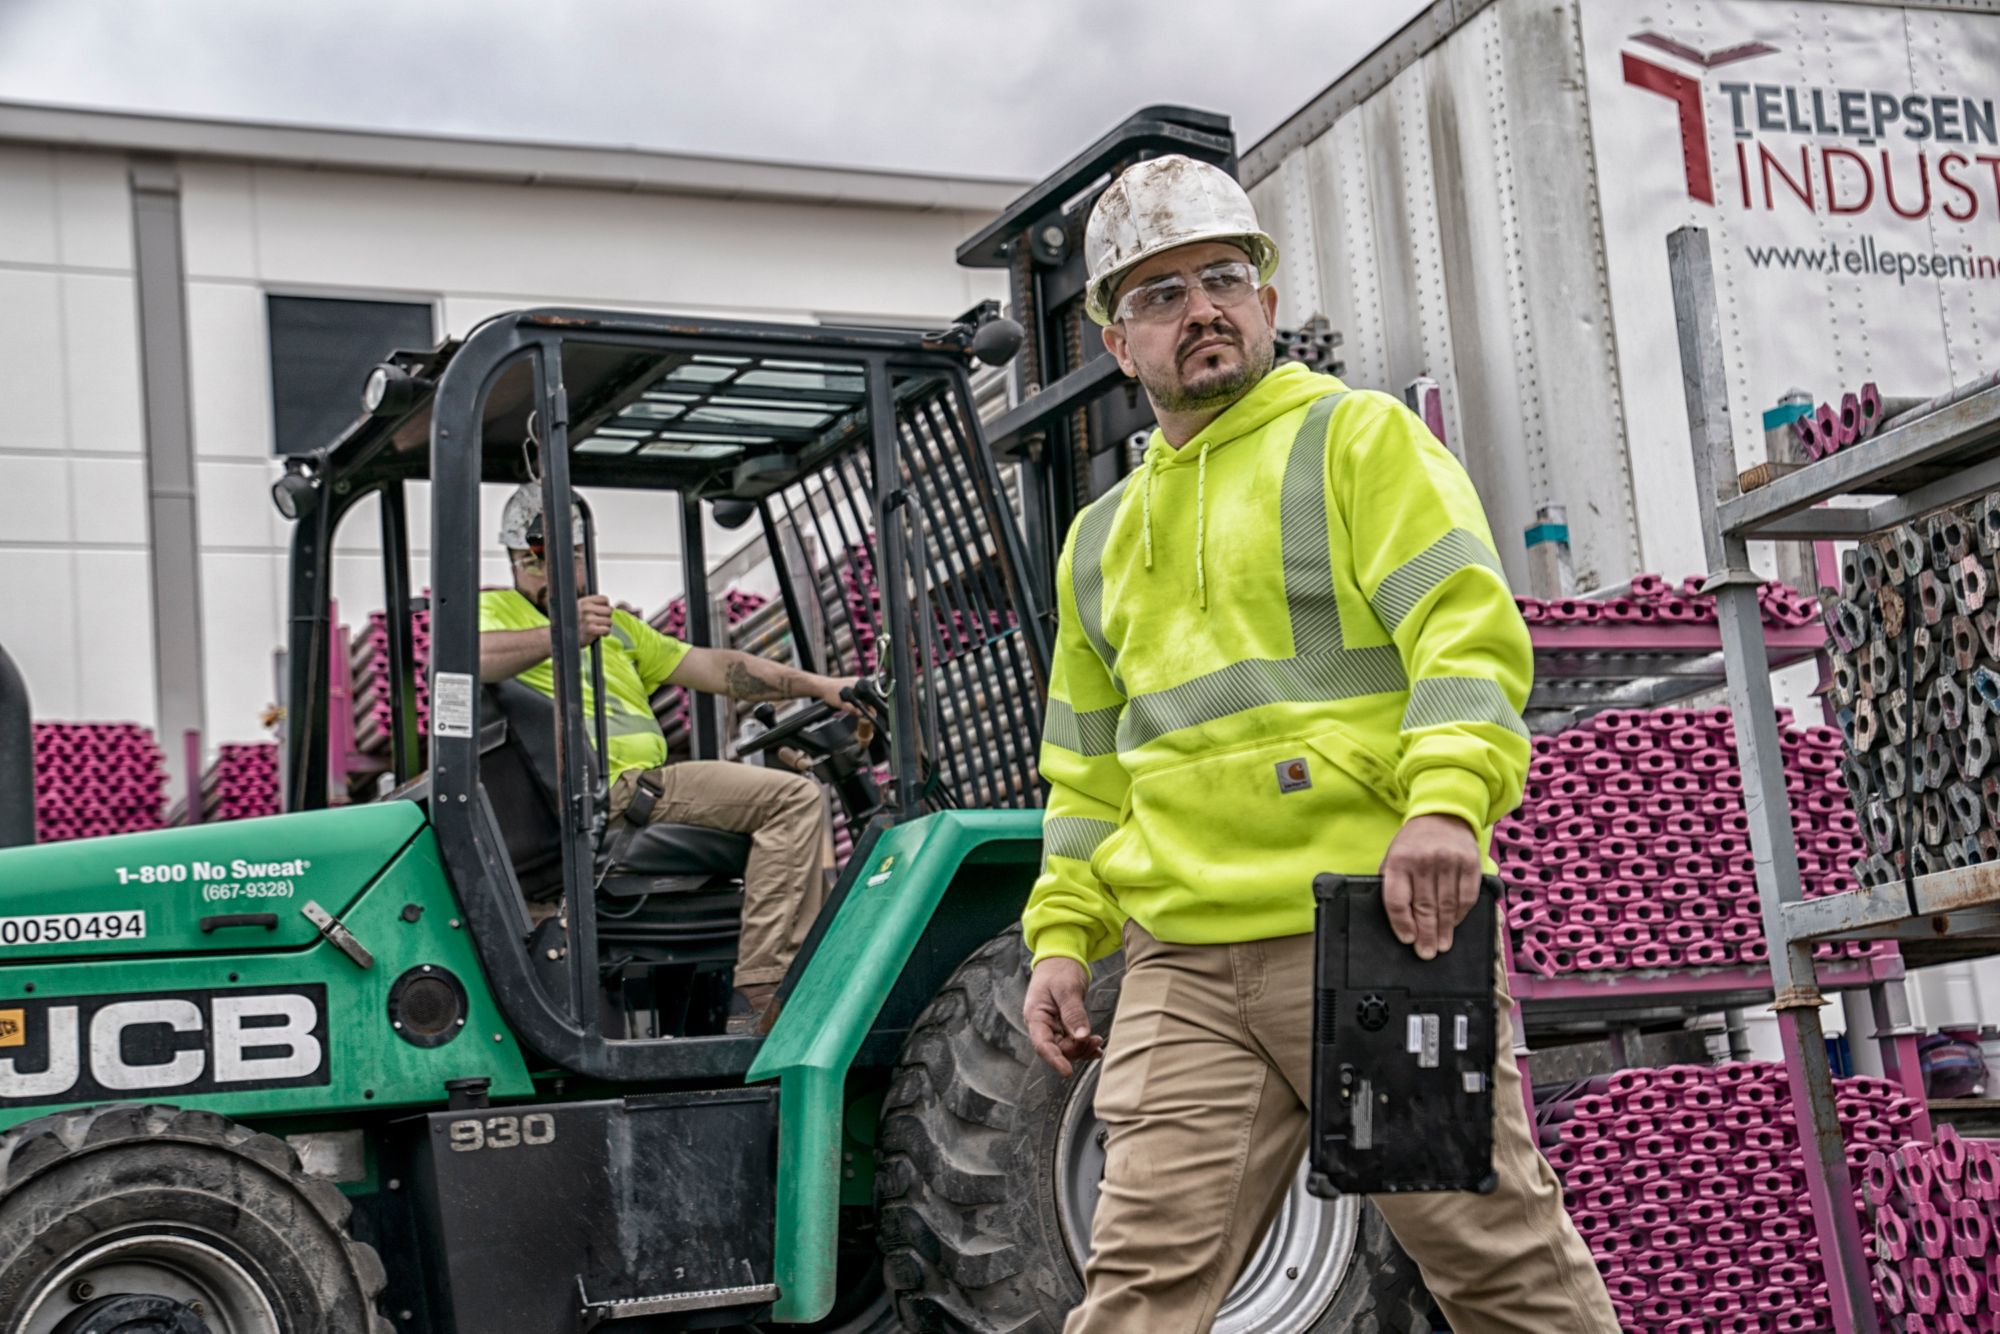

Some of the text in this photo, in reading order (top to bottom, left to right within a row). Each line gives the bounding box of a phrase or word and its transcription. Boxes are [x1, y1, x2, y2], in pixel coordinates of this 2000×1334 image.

[1719, 80, 1999, 146] TELLEPSEN
[1746, 234, 2000, 286] www.tellepsenin
[115, 864, 187, 885] 1-800
[192, 861, 227, 881] No
[202, 880, 294, 902] (667-9328)
[1, 914, 143, 944] 0050494
[0, 994, 322, 1098] JCB
[450, 1113, 555, 1152] 930
